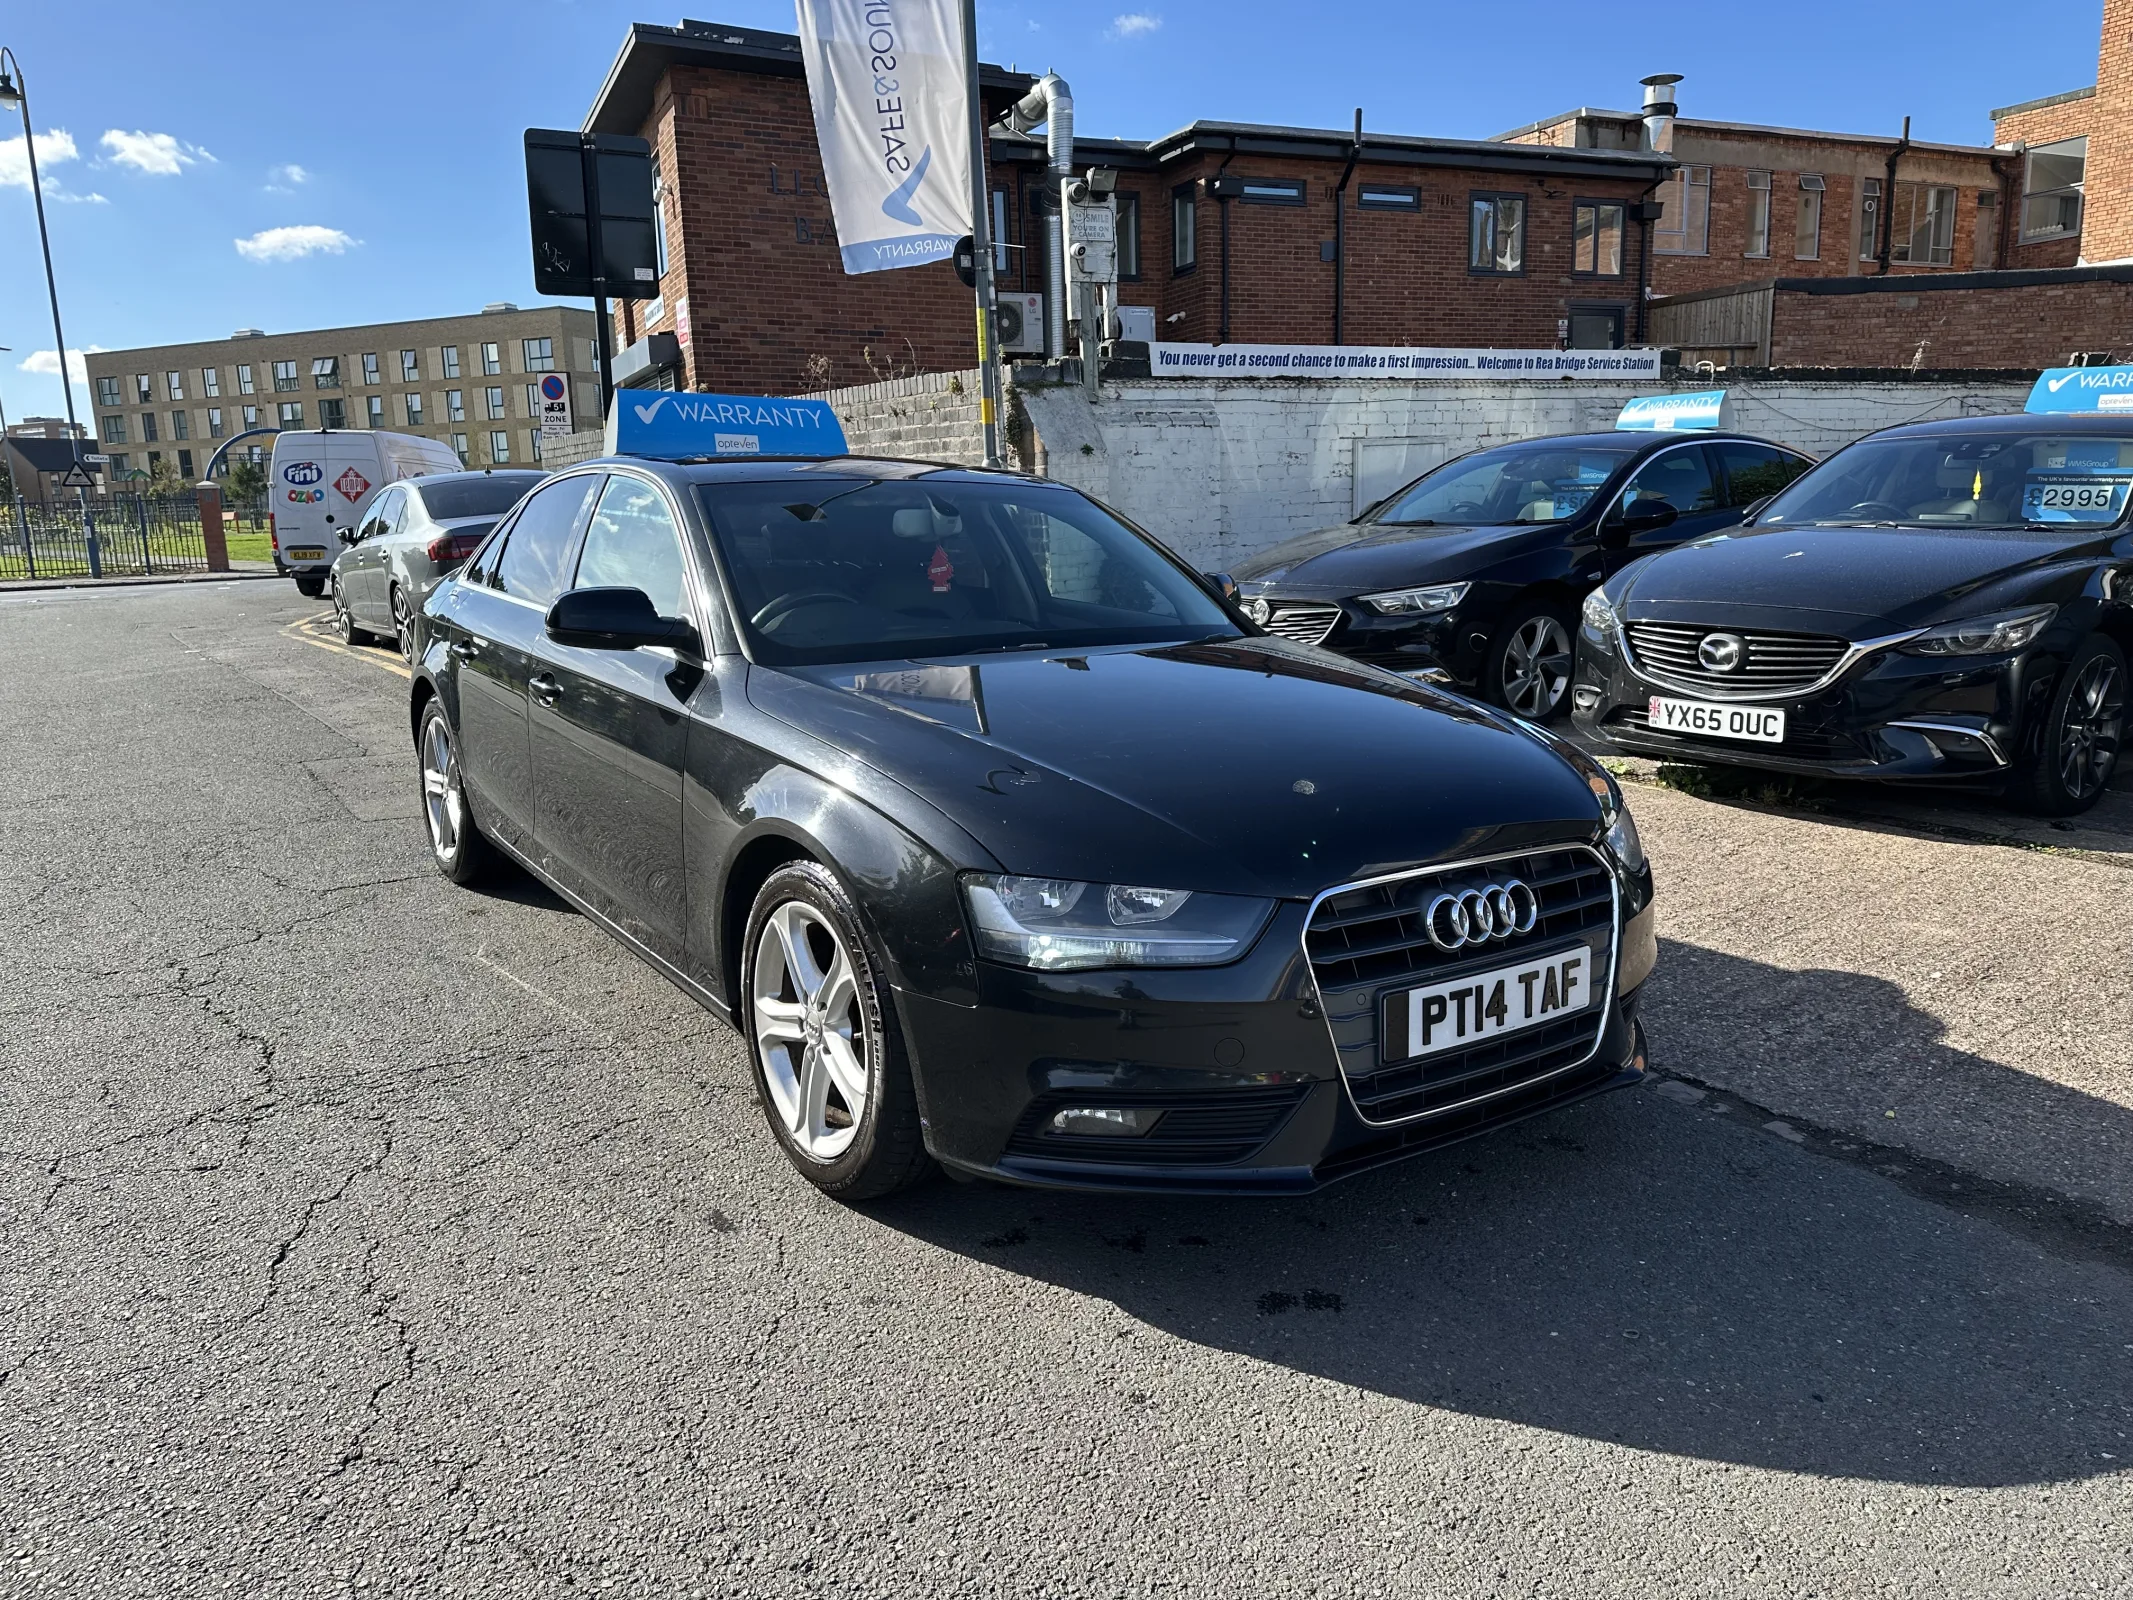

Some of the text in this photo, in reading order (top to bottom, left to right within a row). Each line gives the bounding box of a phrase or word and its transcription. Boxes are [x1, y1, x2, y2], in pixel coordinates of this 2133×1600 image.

[1086, 213, 1109, 223] SMILE
[1159, 351, 1655, 371] You never get a second chance to make a first impression... Welcome to Rea Bridge Service Station
[1646, 397, 1717, 412] WARRANTY
[544, 415, 567, 423] ZONE
[672, 400, 821, 429] WARRANTY
[717, 436, 758, 450] opteven
[287, 463, 318, 483] Fini
[2067, 460, 2109, 468] WMSGroup
[2028, 488, 2109, 507] £2995
[1664, 703, 1778, 737] YX65 OUC
[1422, 957, 1581, 1046] PT14 TAF
